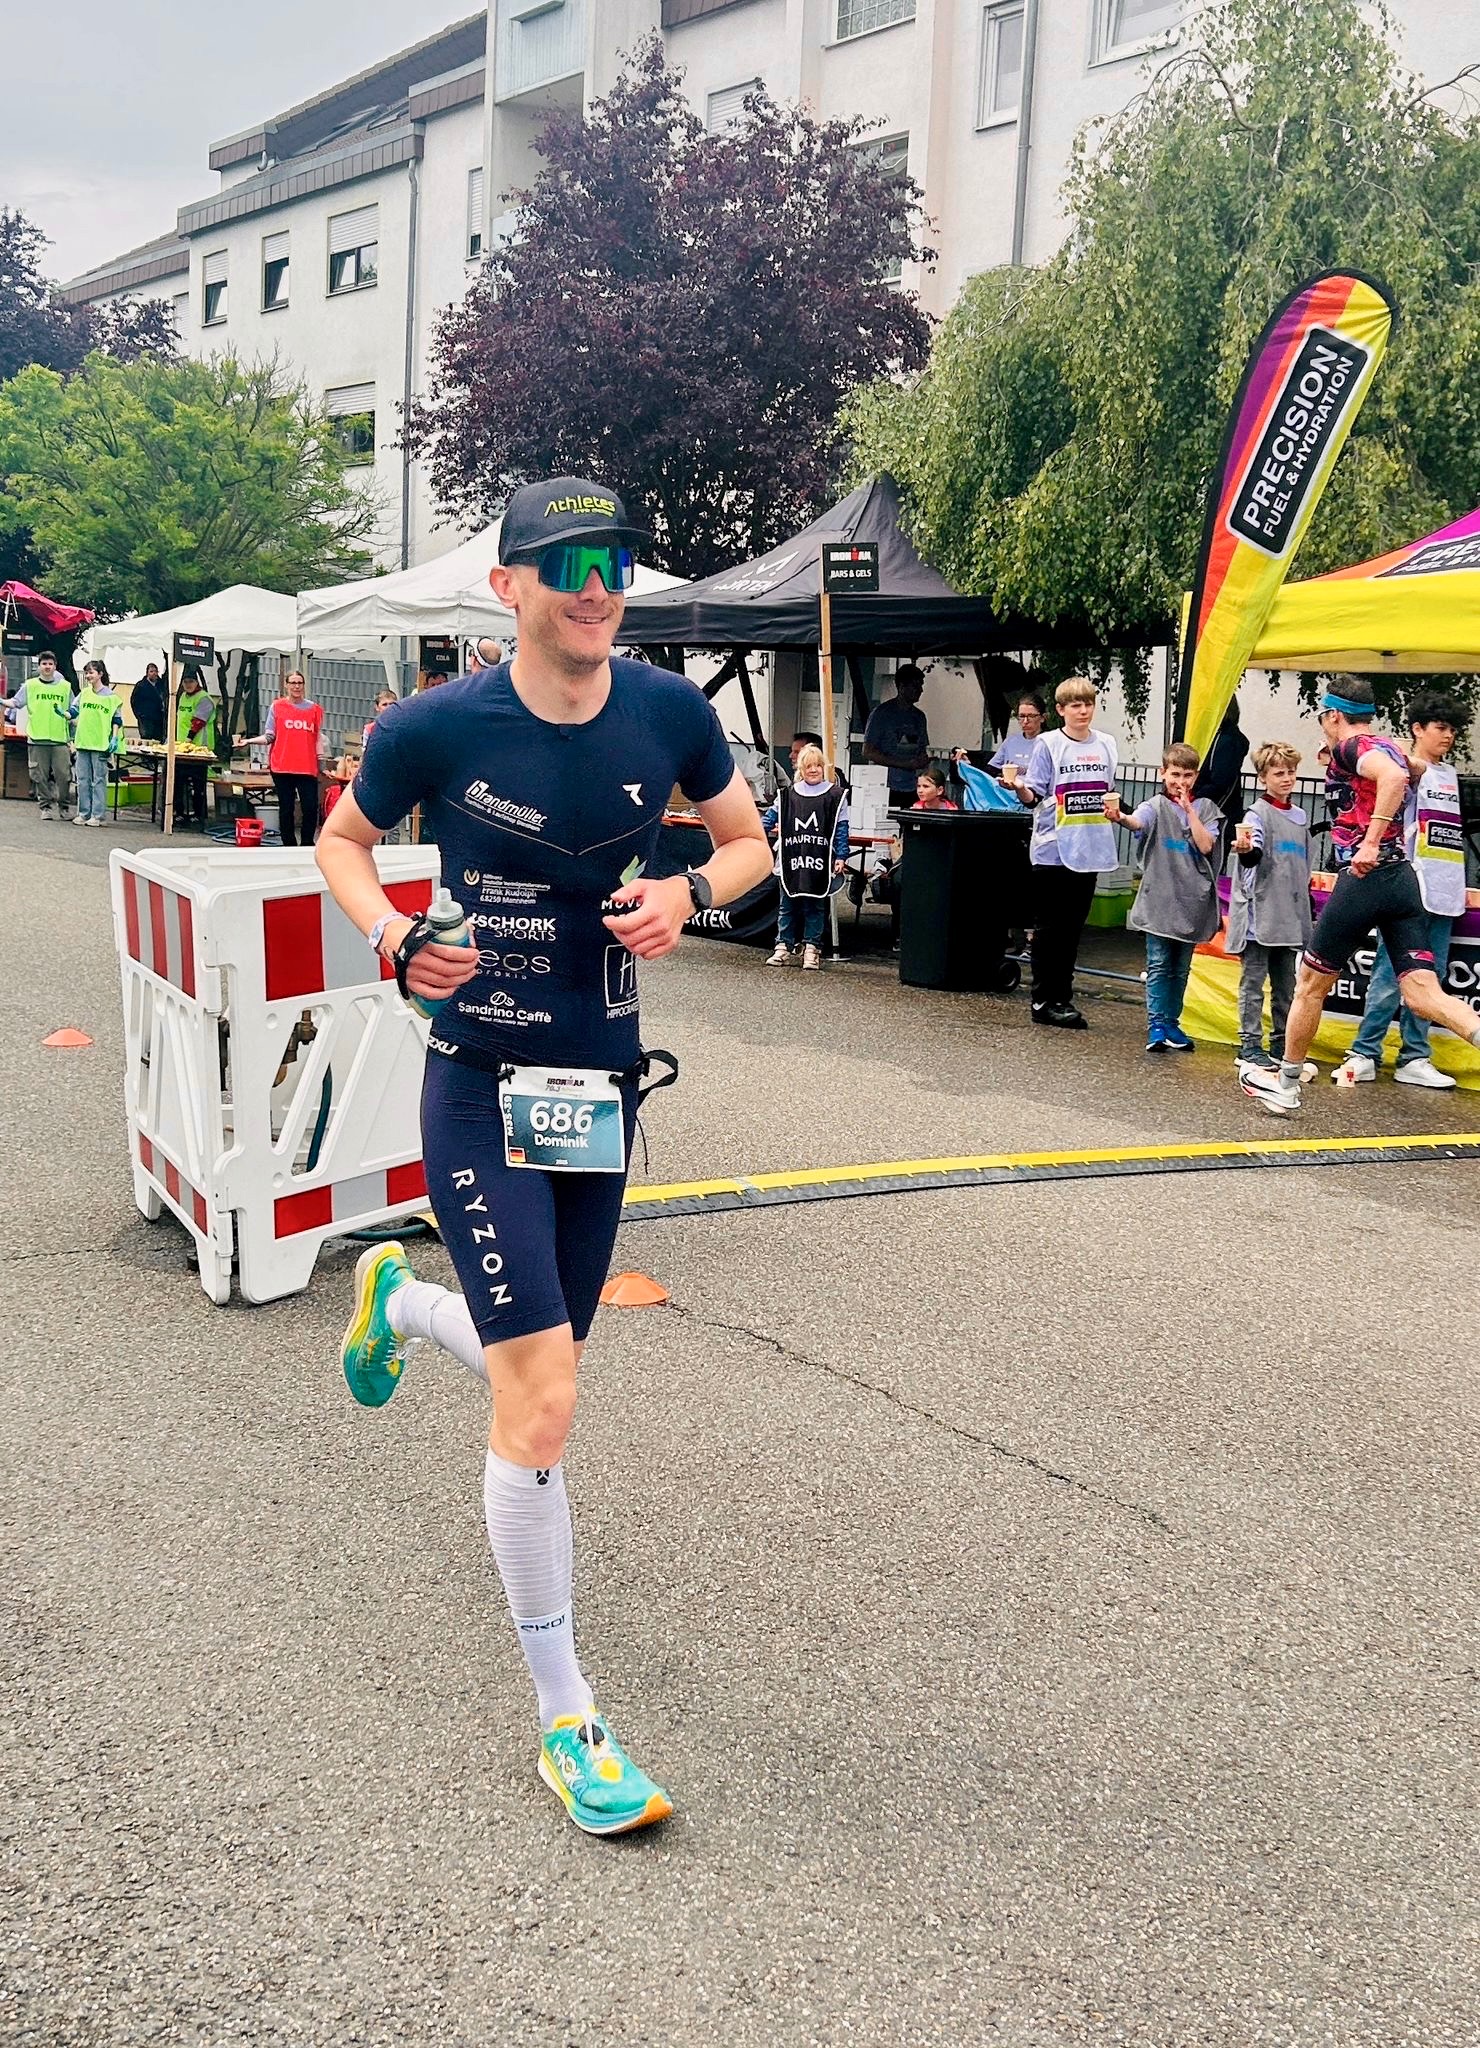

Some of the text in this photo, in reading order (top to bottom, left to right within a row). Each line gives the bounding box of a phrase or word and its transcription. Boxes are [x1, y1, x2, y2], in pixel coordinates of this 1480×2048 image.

[1242, 344, 1338, 528] PRECISION
[1263, 357, 1353, 538] FUEL & HYDRATION
[544, 495, 616, 518] Athletes
[1410, 540, 1480, 566] PRE
[830, 569, 872, 579] BARS & GELS
[436, 654, 450, 662] COLA
[36, 693, 64, 703] FRUITS
[83, 702, 110, 714] FRUITS
[785, 834, 829, 847] MAURTEN
[790, 856, 824, 870] BARS
[481, 887, 503, 896] Frank
[477, 914, 557, 930] SCHORK
[494, 928, 556, 941] SPORTS
[458, 1001, 552, 1023] Sandrino Caffè
[530, 1100, 595, 1134] 686
[534, 1133, 589, 1148] Dominik
[451, 1168, 513, 1306] RYZON
[552, 1740, 589, 1801] HOKA
